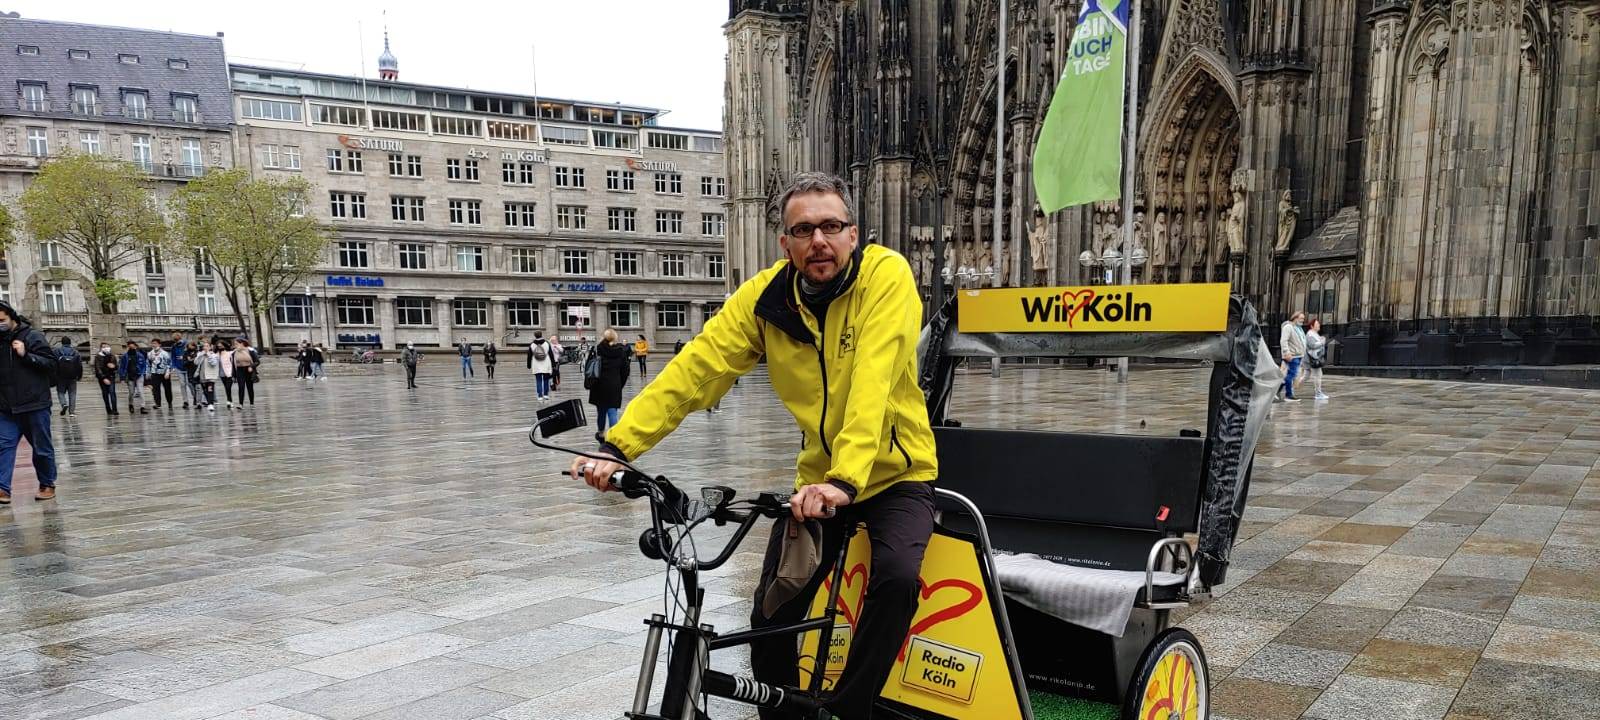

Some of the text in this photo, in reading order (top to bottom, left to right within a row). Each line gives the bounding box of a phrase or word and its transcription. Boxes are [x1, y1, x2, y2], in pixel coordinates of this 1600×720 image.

[1069, 35, 1113, 59] UCH
[360, 138, 403, 152] SATURN
[501, 149, 513, 160] in
[517, 151, 545, 163] Köln
[642, 160, 678, 172] SATURN
[1021, 292, 1152, 323] Wir Köln
[829, 633, 846, 647] adio
[922, 650, 965, 672] Radio
[922, 668, 956, 689] Köln
